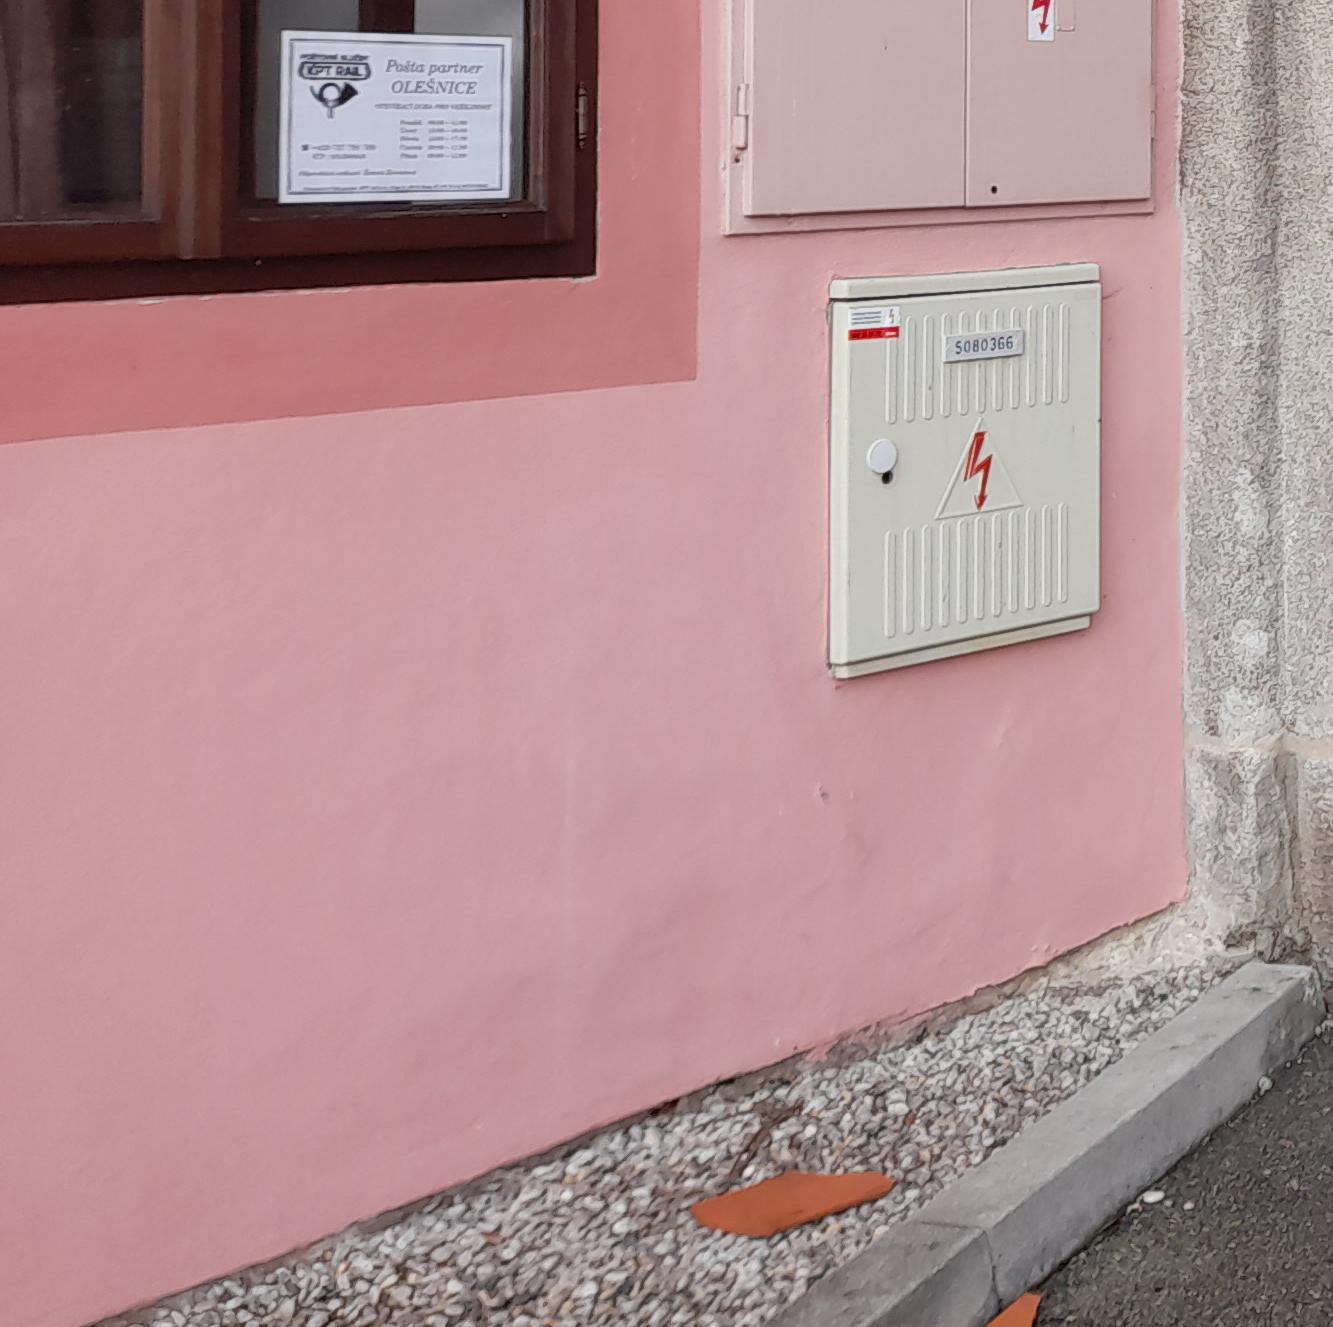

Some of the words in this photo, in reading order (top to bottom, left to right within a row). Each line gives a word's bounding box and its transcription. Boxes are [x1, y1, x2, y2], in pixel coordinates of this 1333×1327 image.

[385, 59, 425, 73] Pošta
[427, 63, 484, 76] partner
[391, 78, 478, 95] OLEŠNICE
